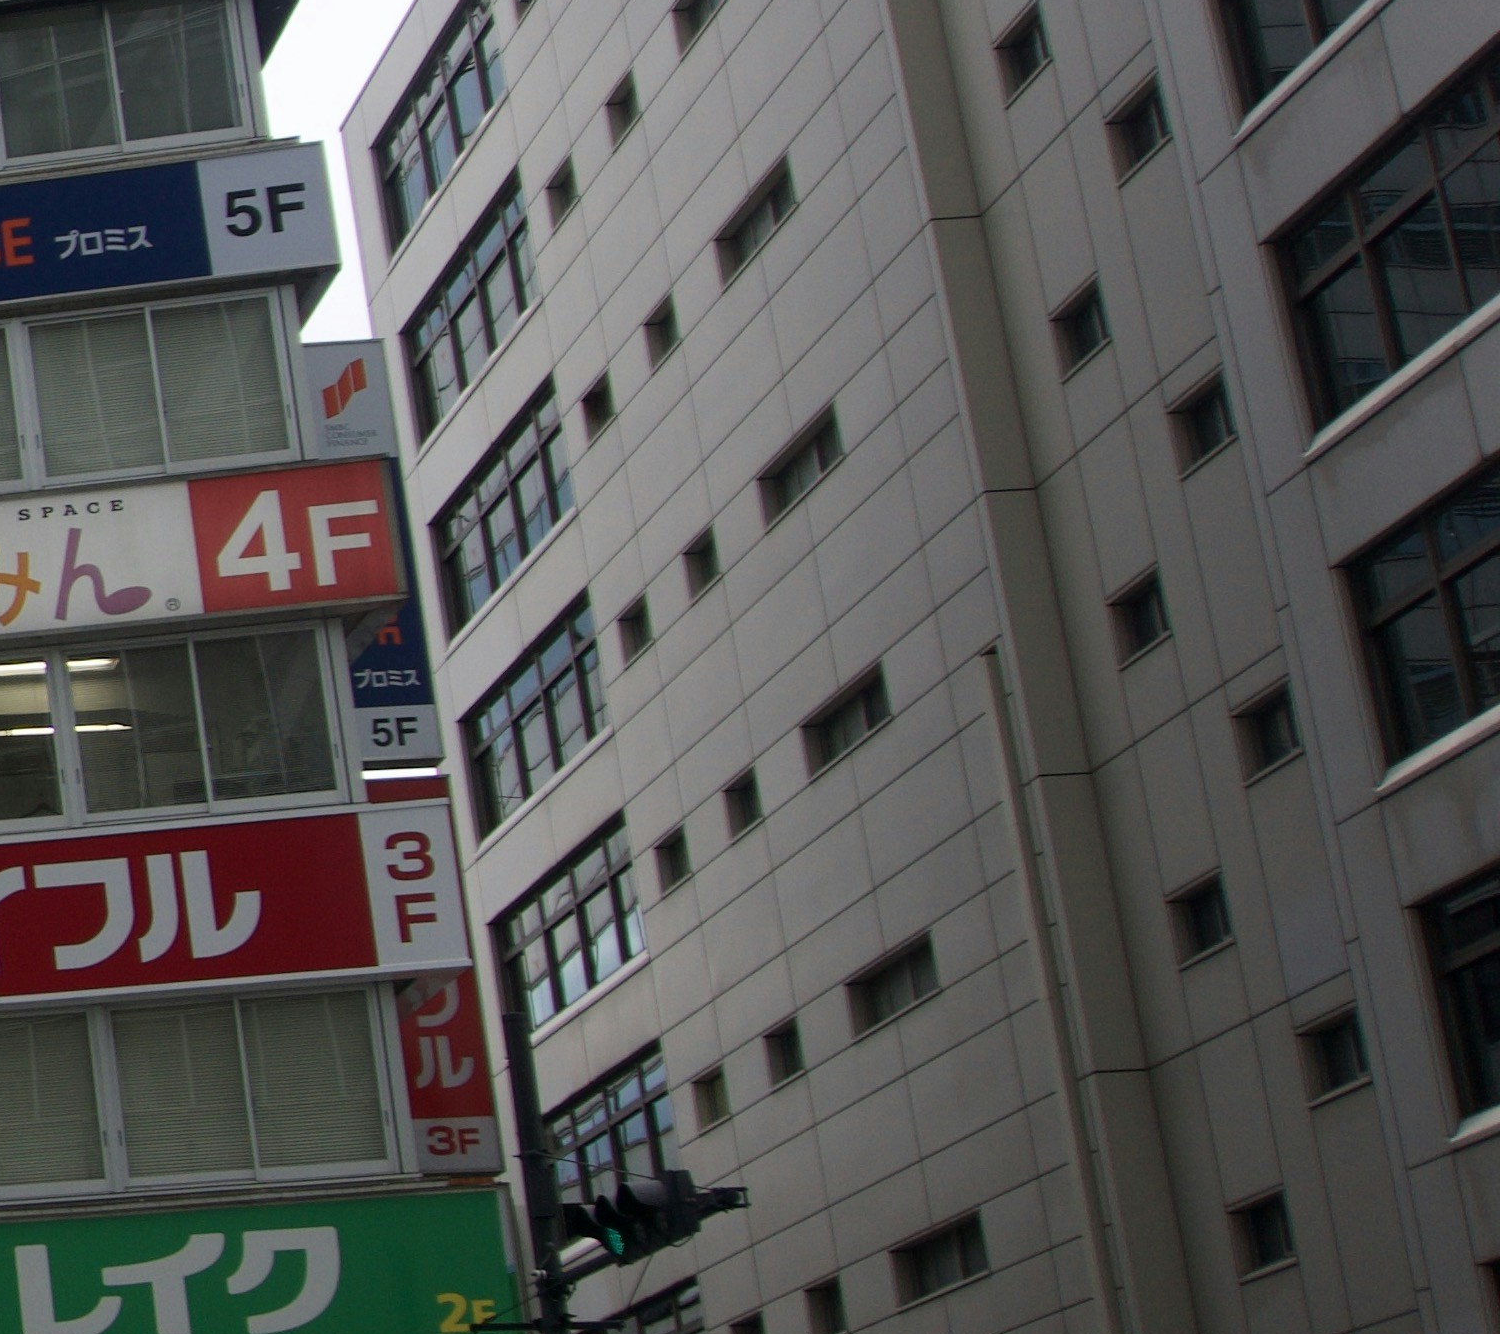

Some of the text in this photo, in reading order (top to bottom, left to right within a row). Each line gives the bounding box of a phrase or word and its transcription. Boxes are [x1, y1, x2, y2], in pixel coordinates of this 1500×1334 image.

[55, 225, 152, 259] プロミス
[225, 182, 305, 238] 5F
[18, 498, 127, 522] SPACE
[217, 490, 378, 592] 4F
[354, 669, 420, 688] プロミス
[371, 716, 419, 747] 5F
[427, 1126, 480, 1156] 3F
